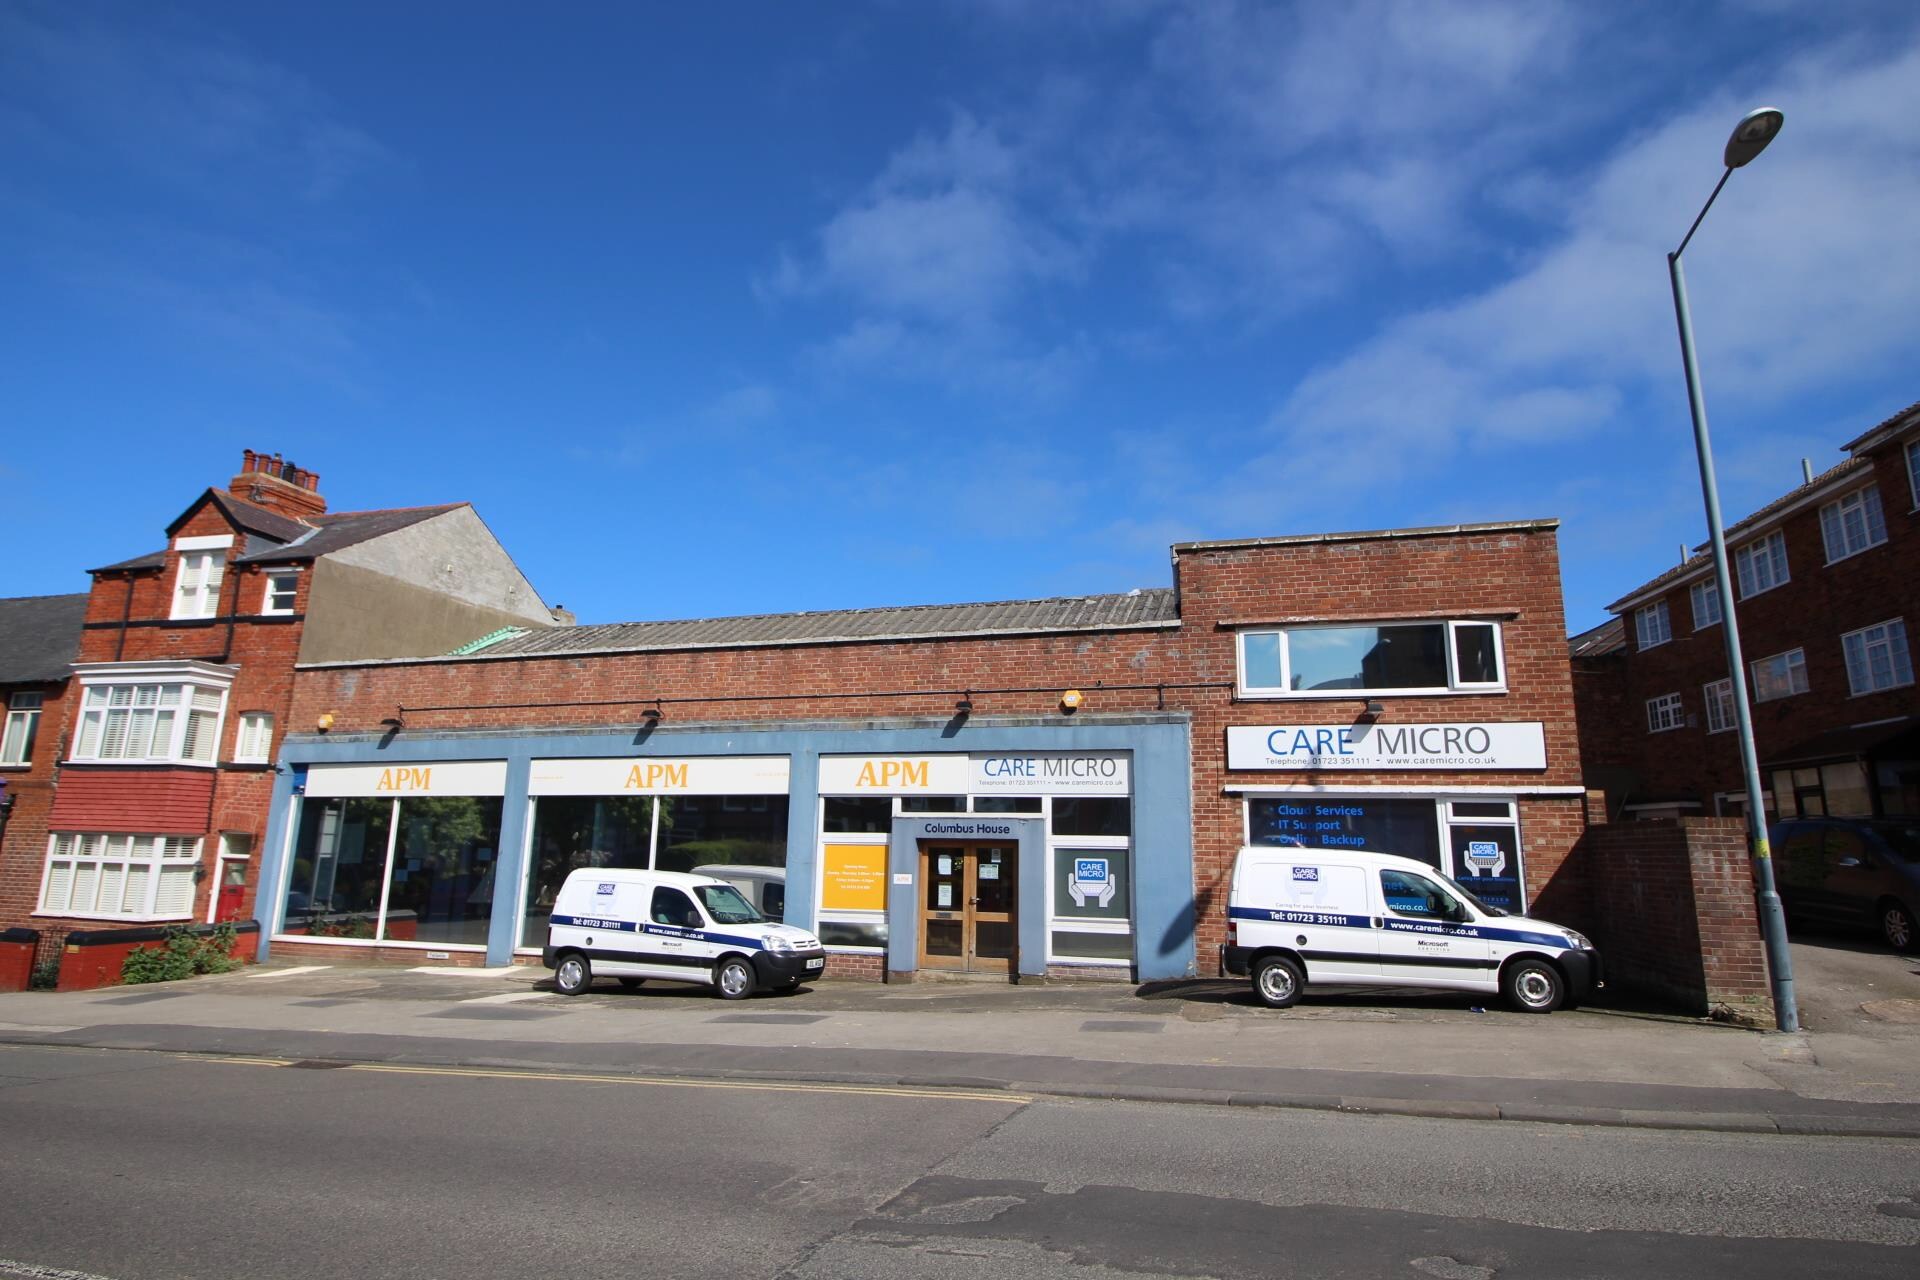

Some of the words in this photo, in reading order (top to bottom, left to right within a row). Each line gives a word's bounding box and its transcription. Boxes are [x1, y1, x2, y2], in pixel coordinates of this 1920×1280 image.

[1267, 729, 1354, 755] CARE
[1377, 727, 1491, 754] MICRO
[984, 758, 1036, 777] CARE
[1043, 758, 1116, 777] MICRO
[1312, 757, 1338, 765] 01723
[1340, 757, 1370, 765] 351111
[1386, 757, 1497, 765] www.caremicro.co.uk
[376, 767, 432, 791] APM
[624, 764, 688, 788] APM
[856, 760, 929, 787] APM
[1278, 805, 1311, 815] Cloud
[1315, 805, 1363, 816] Services
[925, 823, 974, 834] Columbus
[976, 824, 1010, 834] House
[1278, 819, 1289, 829] IT
[1322, 834, 1365, 848] Backup
[1080, 862, 1103, 871] CARE
[1079, 870, 1104, 878] MICRO
[572, 918, 583, 926] Tel:
[583, 918, 601, 927] 01723
[602, 920, 621, 929] 351111
[1270, 911, 1286, 920] Tel:
[1287, 912, 1314, 923] 01723
[1317, 914, 1347, 925] 351111
[1390, 921, 1479, 936] www.caremicro.co.uk
